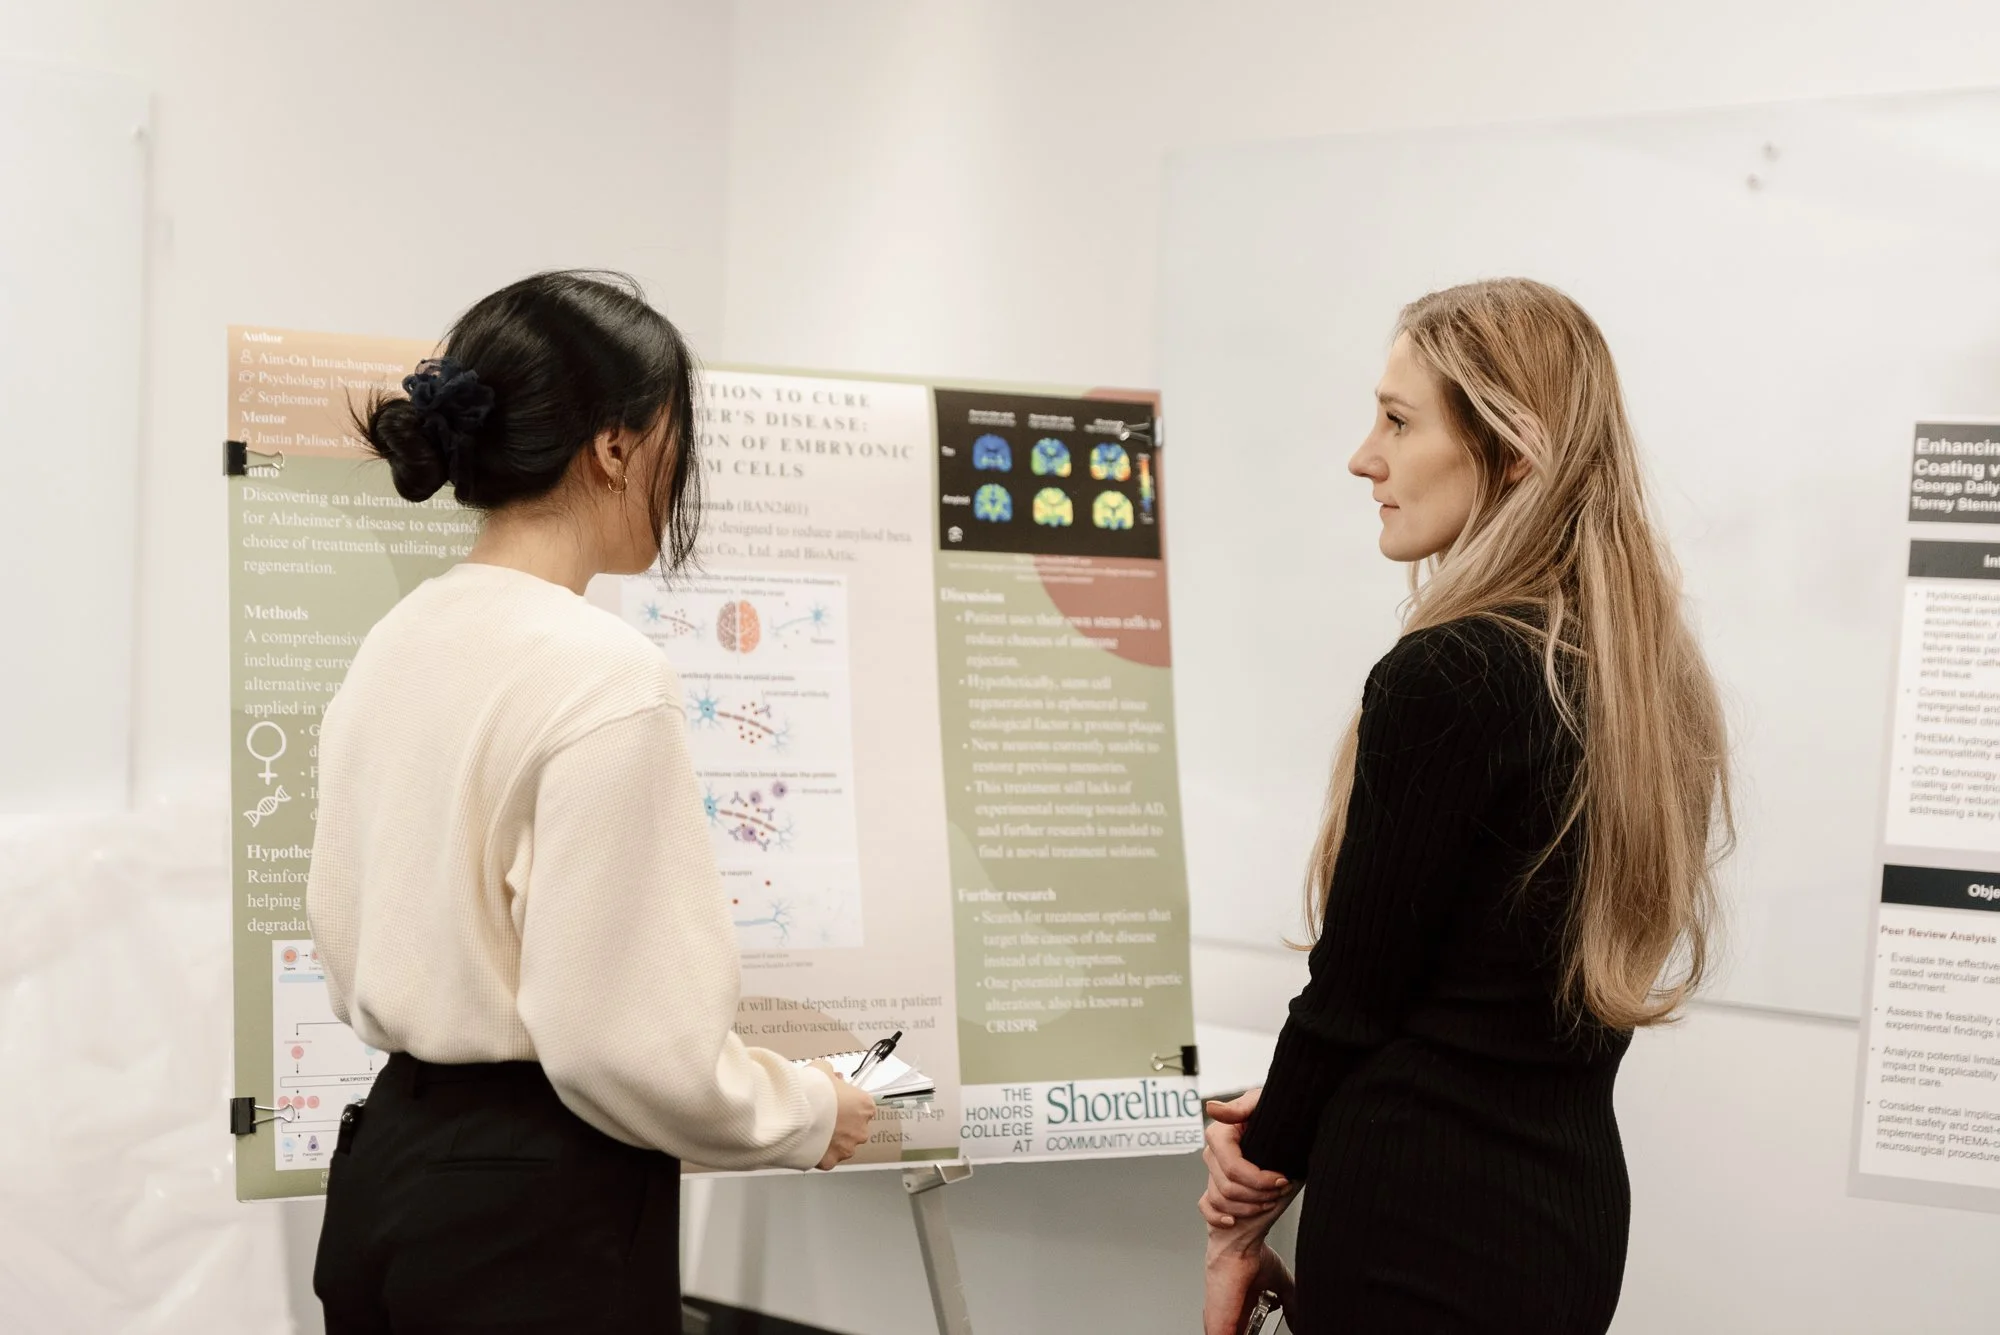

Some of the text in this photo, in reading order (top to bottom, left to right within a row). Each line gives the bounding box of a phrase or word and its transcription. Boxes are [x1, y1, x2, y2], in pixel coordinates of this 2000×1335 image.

[242, 330, 284, 344] Author
[258, 354, 308, 366] Aim-On
[258, 372, 327, 388] Psychology
[258, 392, 328, 407] Sophomore
[776, 388, 801, 403] TO
[812, 390, 871, 408] CURE
[242, 411, 287, 424] Mentor
[766, 412, 868, 432] DISEASE:
[256, 432, 292, 445] Justin
[742, 435, 768, 450] OF
[780, 438, 914, 460] EMBRYONIC
[734, 460, 804, 478] CELLS
[1914, 458, 1985, 480] Coating
[1912, 478, 1962, 496] George
[242, 487, 328, 506] Discovering
[332, 494, 350, 504] an
[1912, 496, 1955, 514] Torrey
[243, 510, 264, 524] for
[269, 512, 351, 528] Alzheimer's
[356, 514, 405, 531] disease
[409, 518, 422, 532] to
[720, 522, 774, 537] designed
[776, 526, 790, 537] to
[792, 525, 832, 538] reduce
[242, 534, 473, 559] choice of treatments utilizing ste
[777, 546, 799, 559] and
[244, 559, 336, 575] regeneration.
[940, 588, 1004, 604] Discussion
[244, 605, 308, 620] Methods
[244, 629, 256, 642] A
[244, 652, 312, 671] including
[244, 676, 322, 692] alternative
[244, 700, 298, 718] applied
[302, 701, 316, 715] in
[974, 780, 1002, 794] This
[1004, 782, 1061, 794] treatment
[1118, 780, 1132, 794] of
[247, 892, 302, 910] helping
[958, 888, 1056, 903] Further research
[982, 908, 1172, 926] Search for treatment options that
[984, 930, 1156, 948] target the causes of the disease
[1880, 924, 1997, 944] Peer Review Analysis
[984, 953, 1126, 970] instead of the symptoms.
[1890, 952, 1935, 965] Evaluate
[1938, 957, 1954, 967] the
[984, 973, 1183, 992] One potential cure could be genetic
[1890, 968, 1980, 982] coated ventricular
[750, 994, 942, 1013] will last depending on a patient
[986, 996, 1144, 1012] alteration, also as known as
[762, 1018, 854, 1034] cardiovascular
[858, 1018, 910, 1031] exercise,
[912, 1016, 936, 1029] and
[1886, 1006, 1994, 1027] Assess the feasibility
[986, 1018, 1038, 1034] CRISPR
[1884, 1020, 1998, 1040] experimental findings
[1884, 1046, 1970, 1064] Analyze potential
[1880, 1074, 1916, 1085] patient
[1882, 1060, 1998, 1082] impact the applicability
[1002, 1088, 1032, 1102] THE
[1046, 1080, 1202, 1125] Shoreline
[966, 1105, 1034, 1122] HONORS
[1879, 1098, 1962, 1117] Consider ethical
[960, 1122, 1033, 1138] COLLEGE
[1878, 1114, 1969, 1132] patient safety and
[870, 1129, 912, 1143] effects.
[1046, 1130, 1202, 1152] COMMUNITY COLLEGE
[1876, 1126, 1946, 1144] implementing
[1012, 1140, 1032, 1153] AT
[1876, 1140, 1944, 1156] neurosurgical
